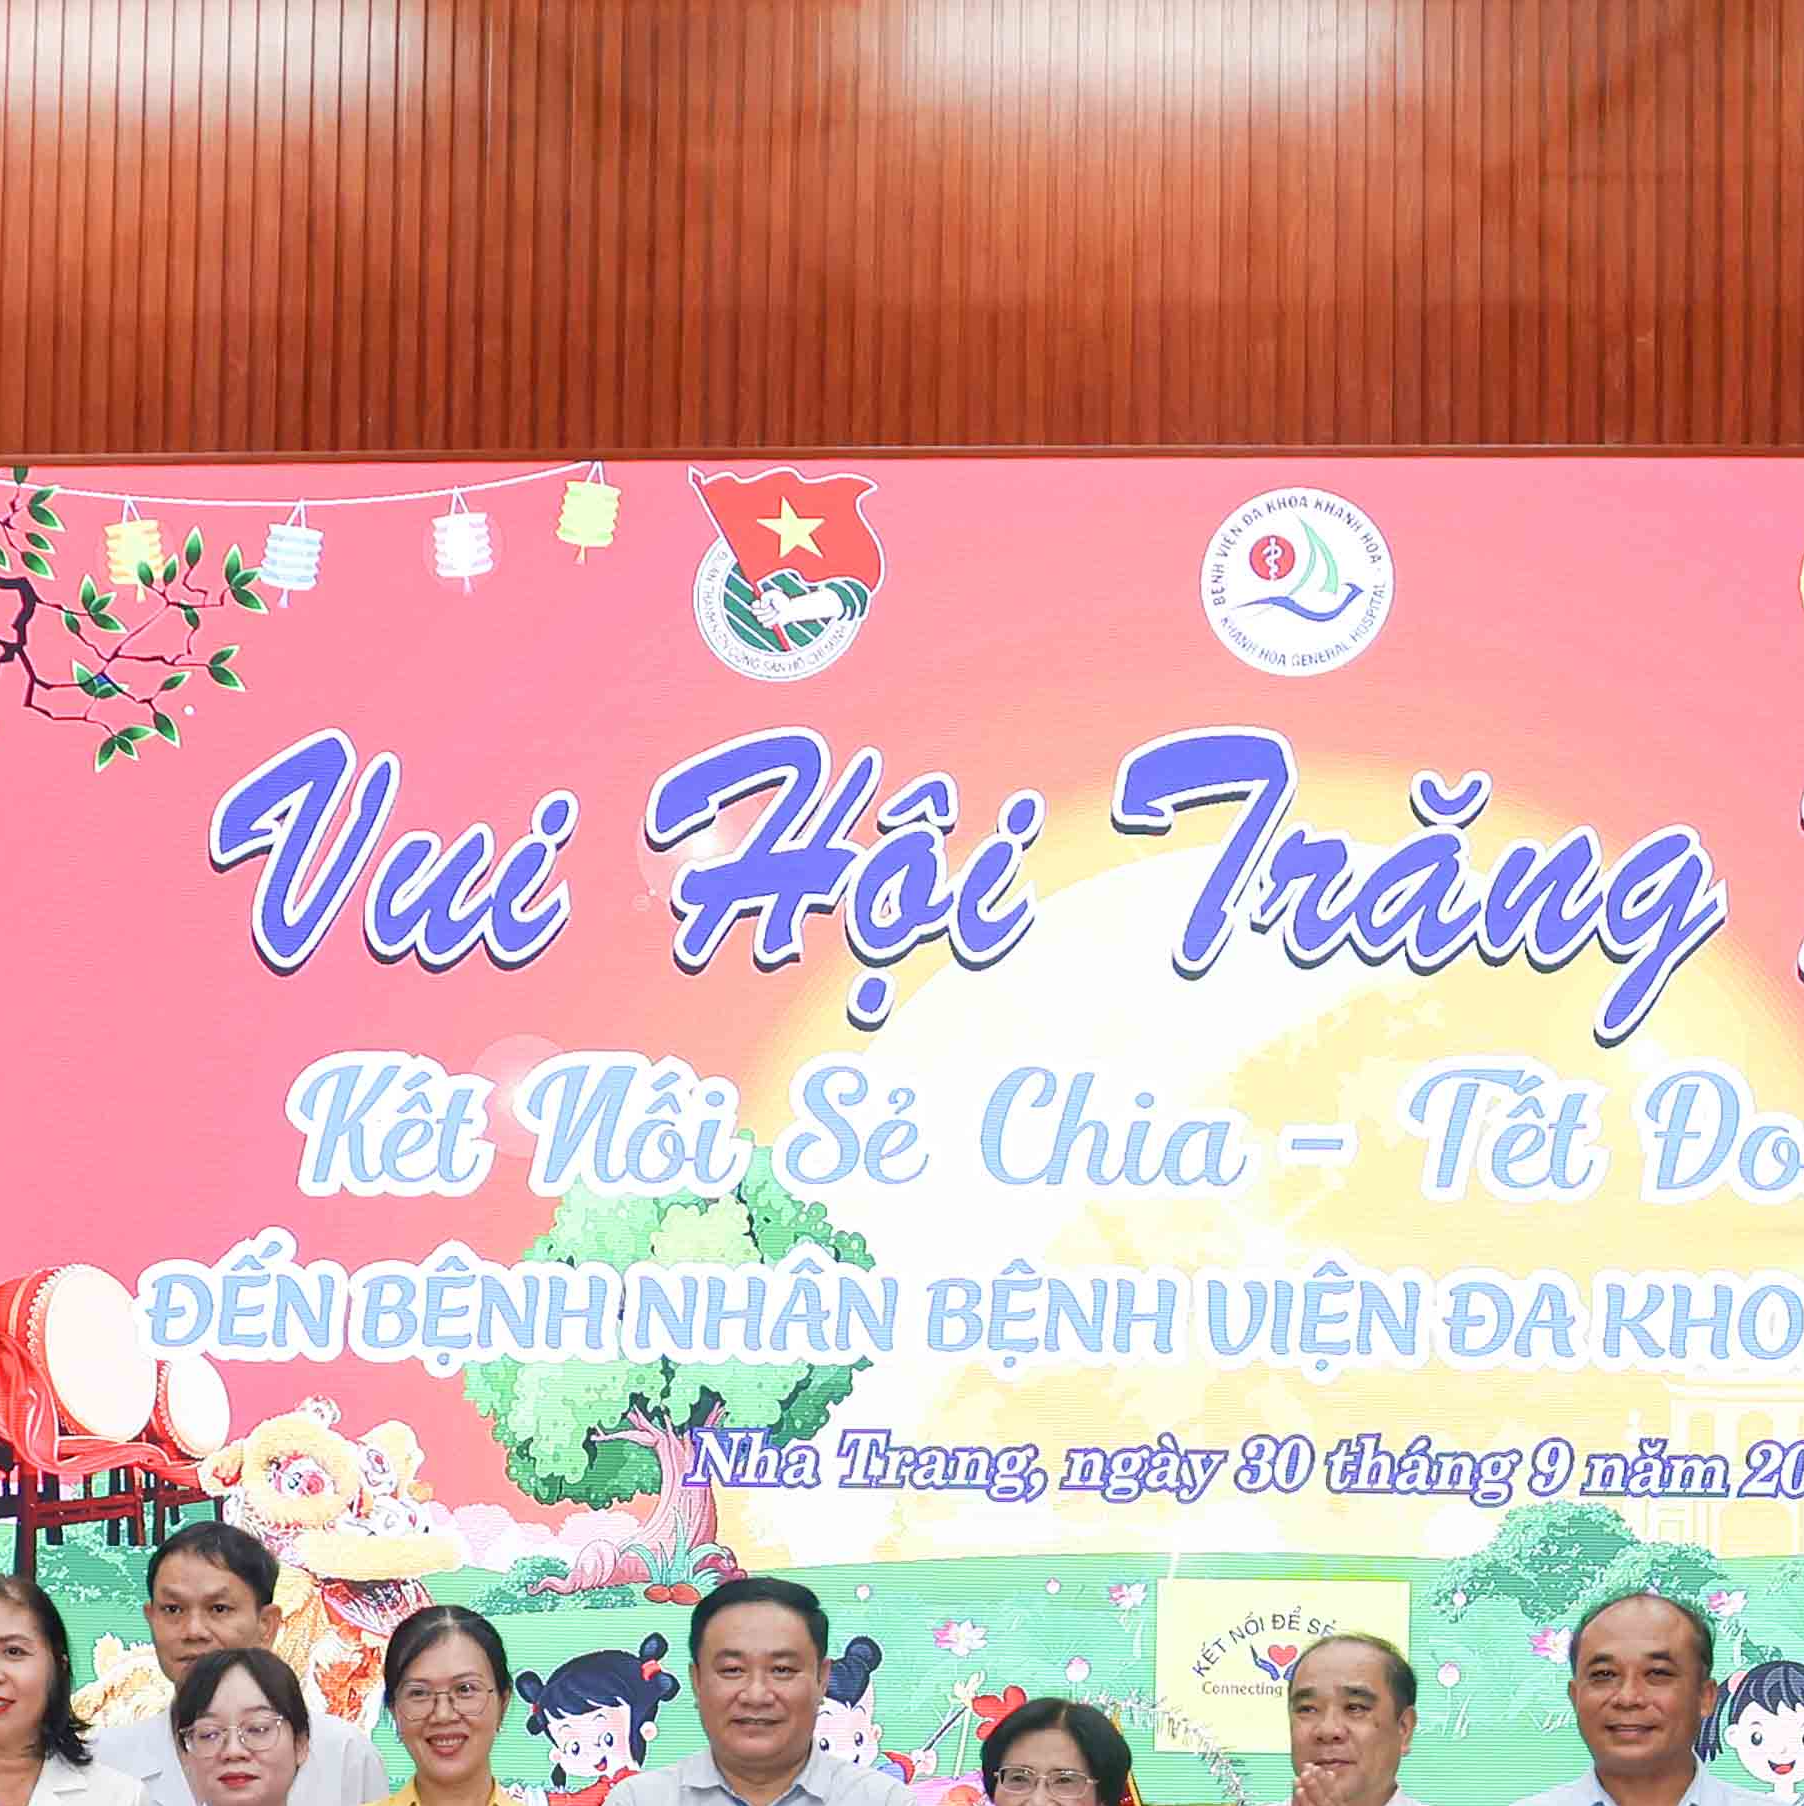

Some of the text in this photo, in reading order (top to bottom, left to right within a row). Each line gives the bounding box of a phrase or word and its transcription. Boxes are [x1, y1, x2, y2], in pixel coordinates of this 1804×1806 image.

[1348, 581, 1388, 644] HOSPITAL
[212, 732, 575, 966] Vui
[647, 728, 1042, 1024] Hội
[1115, 730, 1724, 1036] Trăng
[297, 1062, 485, 1188] Kết
[523, 1062, 743, 1188] Nối
[783, 1060, 929, 1188] Sẻ
[977, 1062, 1246, 1188] Chia
[1406, 1064, 1591, 1192] Tết
[143, 1239, 337, 1350] ĐẾN
[359, 1255, 611, 1370] BỆNH
[631, 1256, 901, 1355] NHÂN
[924, 1257, 1180, 1372] BỆNH
[1205, 1260, 1423, 1376] VIỆN
[1441, 1278, 1577, 1361] ĐA
[682, 1427, 822, 1489] Nha
[837, 1428, 1050, 1503] Trang,
[1059, 1432, 1229, 1504] ngày
[1234, 1433, 1316, 1494] 30
[1326, 1432, 1523, 1507] tháng
[1530, 1436, 1576, 1496] 9
[1581, 1437, 1730, 1498] năm
[1201, 1680, 1284, 1698] Connecting
